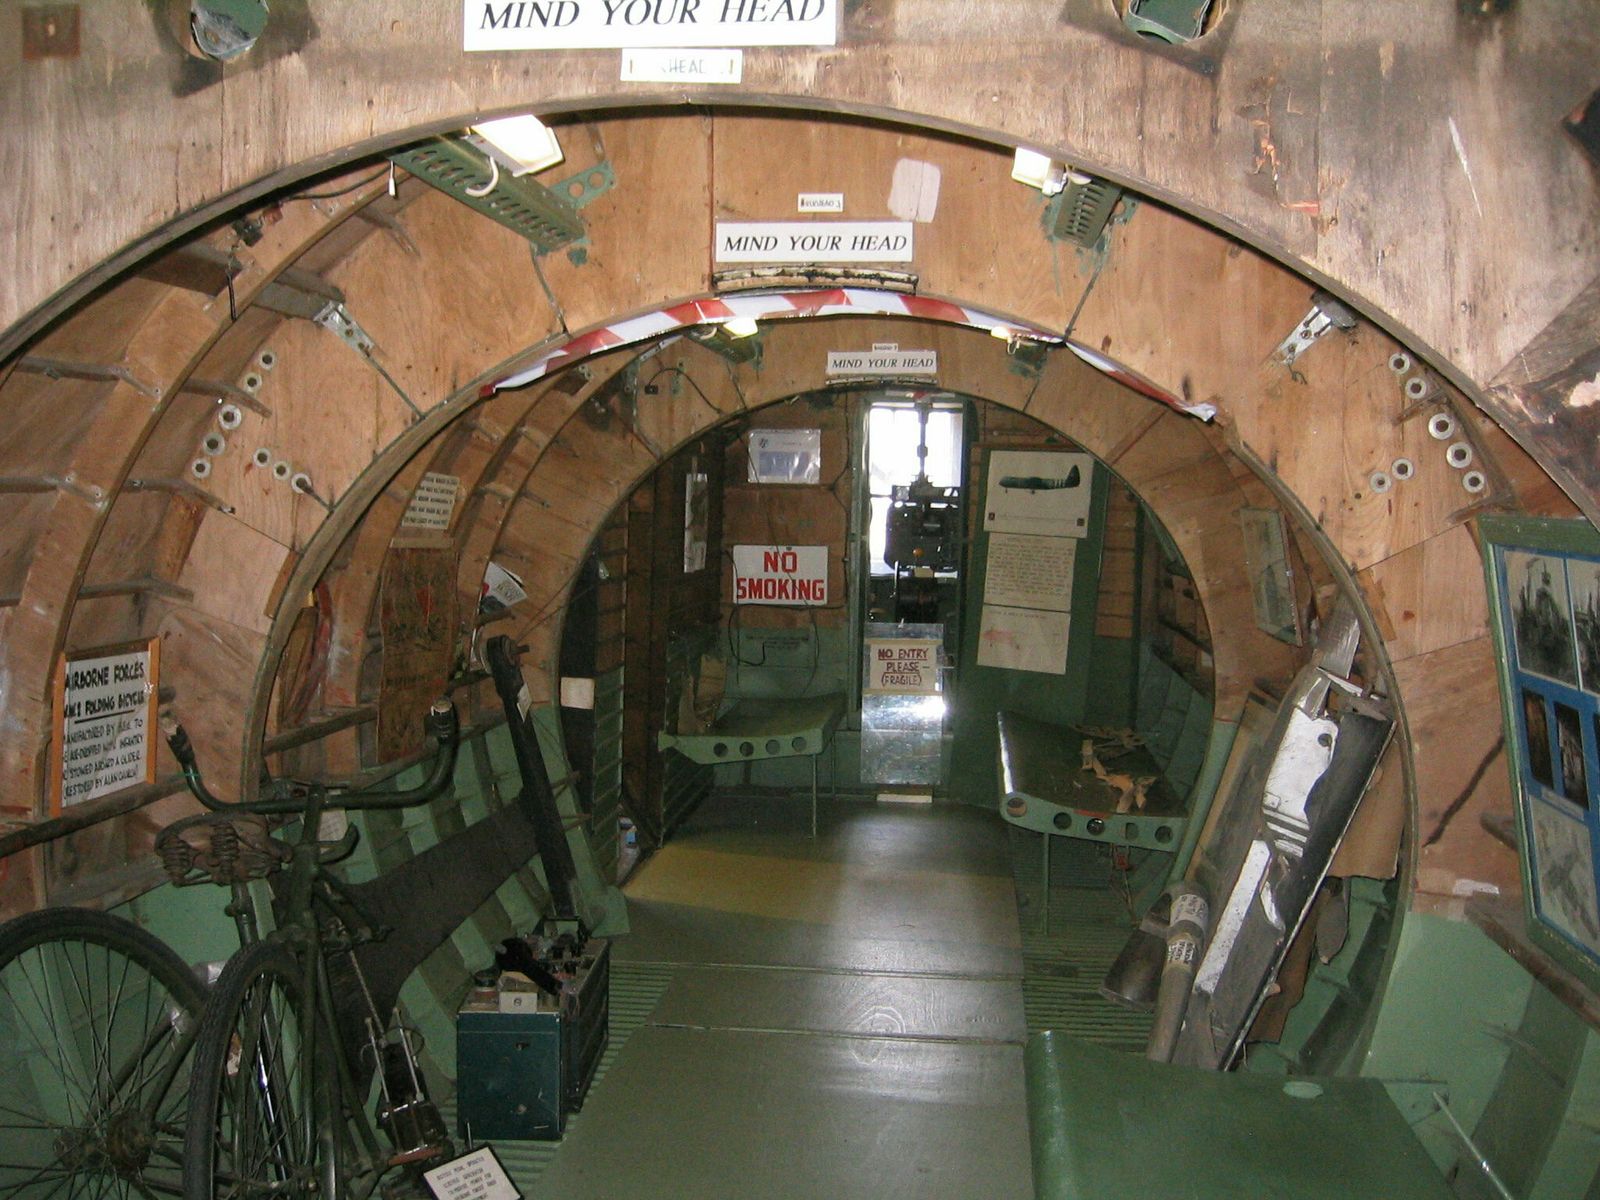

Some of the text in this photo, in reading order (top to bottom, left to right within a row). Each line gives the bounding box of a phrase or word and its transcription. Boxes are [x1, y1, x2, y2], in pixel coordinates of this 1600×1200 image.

[480, 0, 825, 29] MIND YOUR HEAD
[724, 235, 907, 251] MIND YOUR HEAD
[832, 358, 934, 369] MIND YOUR HEAD
[763, 551, 797, 573] NO
[736, 578, 825, 600] SMOKING
[878, 648, 929, 659] NO ENTRY
[886, 661, 920, 672] PLEASE
[65, 661, 145, 691] AIRBORNE FORCES
[881, 673, 922, 687] (FRAGILE)
[85, 695, 115, 715] FOLDING
[118, 690, 144, 709] BICYCLE
[134, 718, 143, 728] TO
[95, 778, 103, 789] BY
